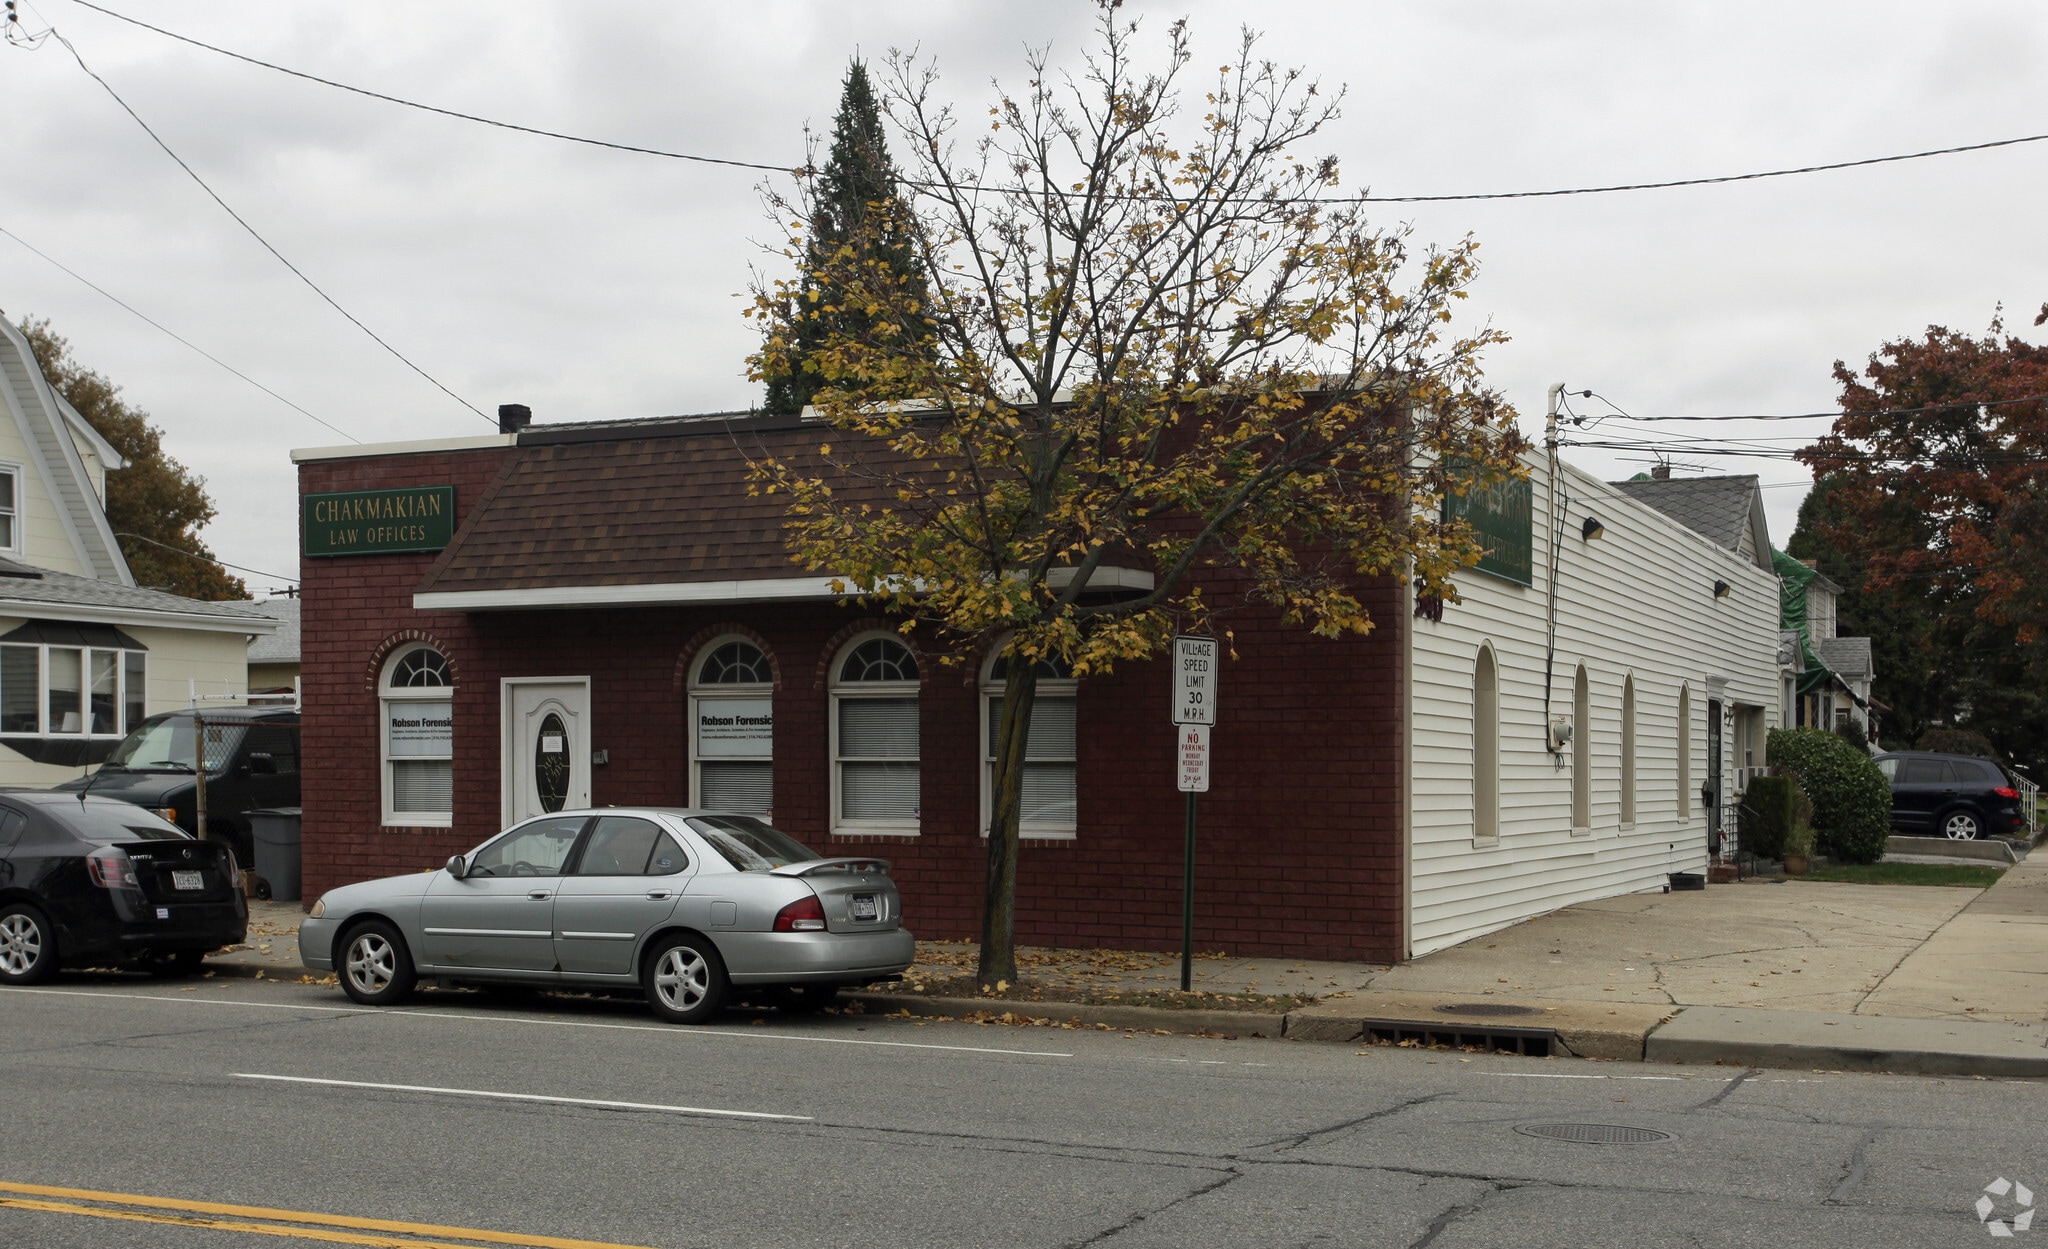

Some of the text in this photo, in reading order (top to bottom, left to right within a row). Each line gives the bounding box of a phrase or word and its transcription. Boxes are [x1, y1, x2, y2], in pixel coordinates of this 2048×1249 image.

[315, 494, 441, 523] CHAKMAKIAN
[330, 525, 426, 545] LAW OFFICES
[1181, 642, 1211, 657] VILLAGE
[1184, 658, 1208, 672] SPEED
[1186, 675, 1205, 688] LIMIT
[1188, 691, 1203, 704] 30
[392, 718, 420, 727] Robson
[701, 715, 773, 725] Robson Forensic
[1187, 733, 1199, 744] NO
[1181, 743, 1206, 752] PARKING
[1186, 766, 1199, 774] FRIDAY
